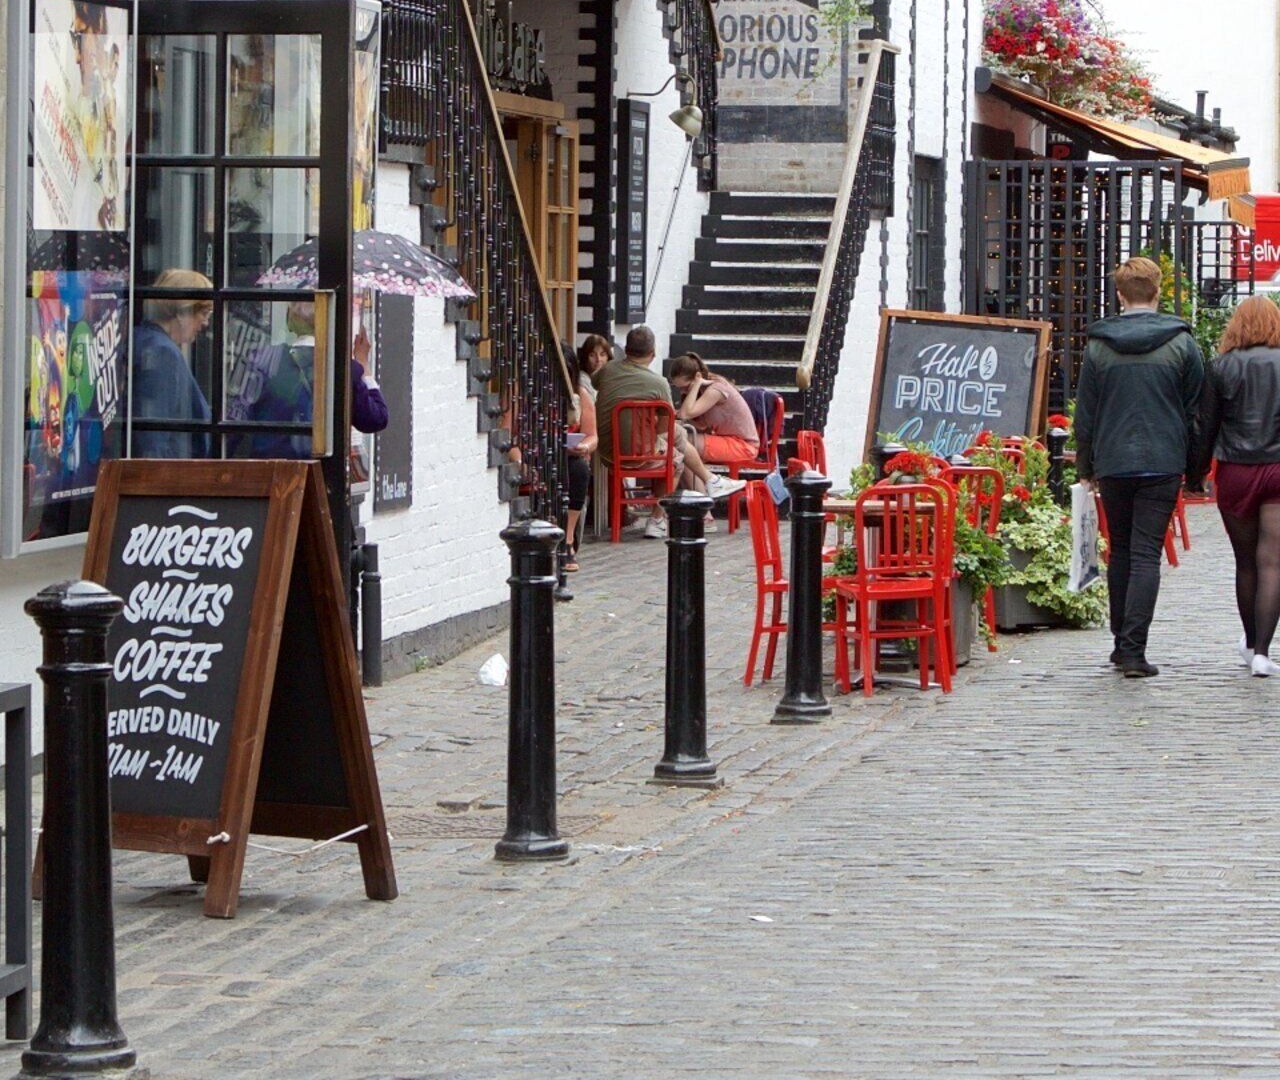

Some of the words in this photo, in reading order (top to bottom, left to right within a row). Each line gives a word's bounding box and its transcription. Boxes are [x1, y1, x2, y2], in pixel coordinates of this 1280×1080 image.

[719, 14, 819, 43] ORIOUS
[721, 47, 820, 80] PHONE
[86, 308, 122, 386] INSIDE
[918, 342, 978, 379] Half
[97, 351, 119, 415] OUT
[895, 375, 1007, 418] PRICE
[122, 523, 253, 569] BURGERS
[123, 580, 234, 627] SHAKES
[113, 638, 223, 683] COFFEE
[107, 705, 165, 737] ERVED
[167, 708, 221, 747] DAILY
